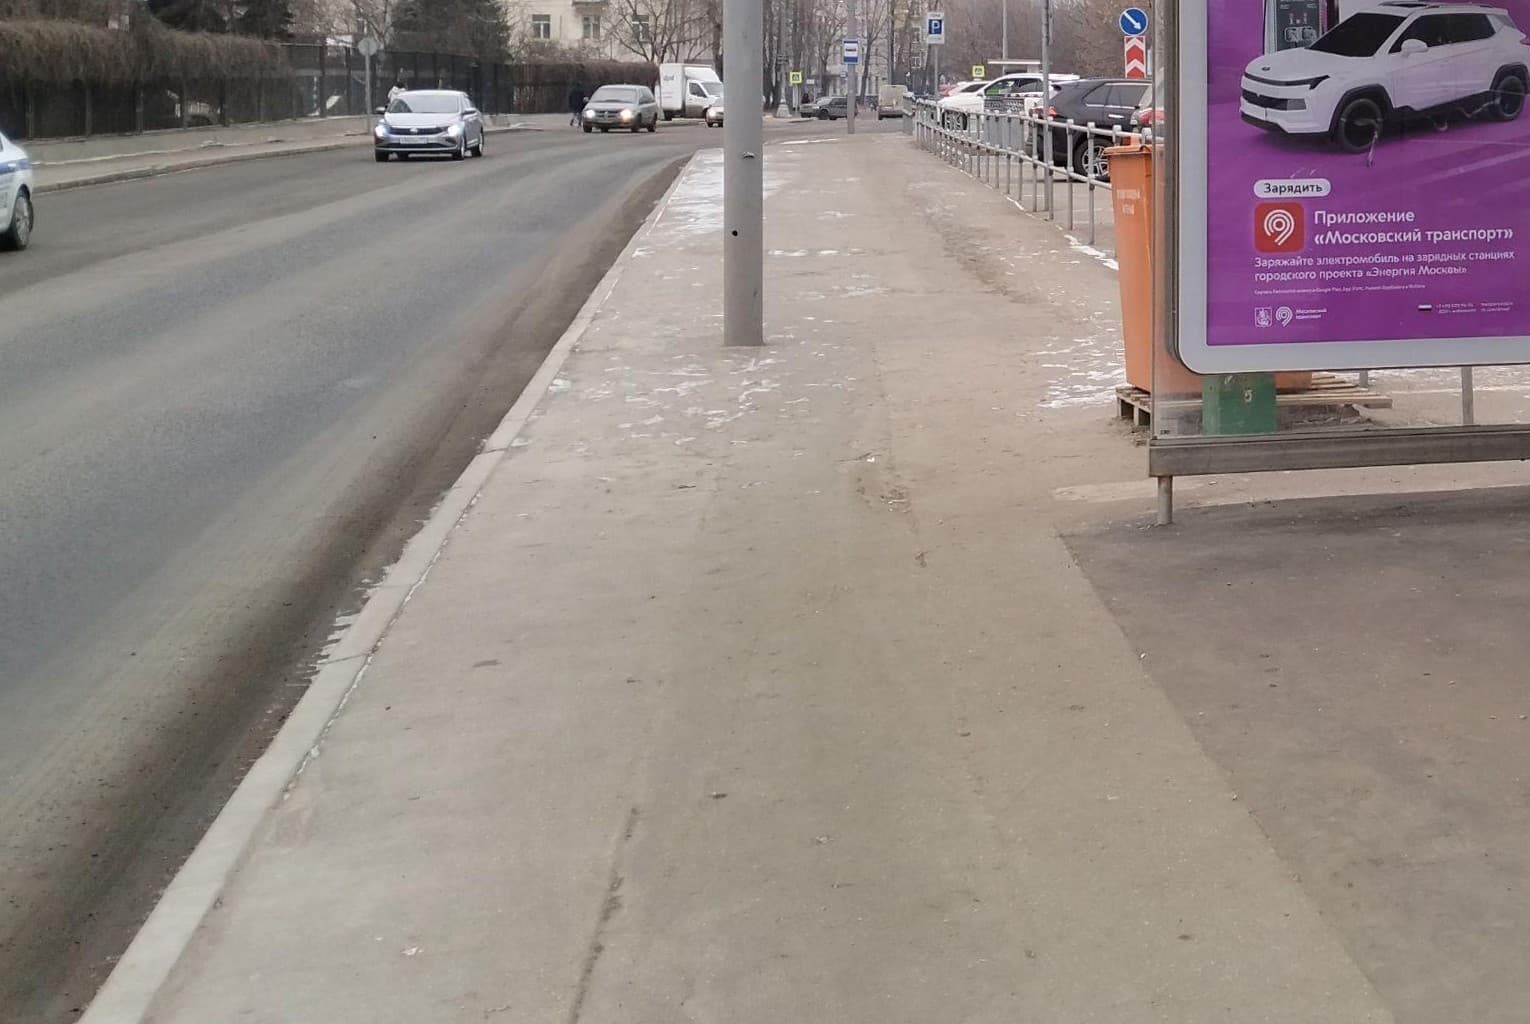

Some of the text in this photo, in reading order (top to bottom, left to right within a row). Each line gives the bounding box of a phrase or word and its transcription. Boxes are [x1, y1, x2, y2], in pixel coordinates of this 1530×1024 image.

[931, 20, 940, 33] P
[1263, 182, 1323, 194] Зарядить
[1314, 210, 1415, 227] Приложение
[1314, 228, 1513, 245] «Московский транспорт»
[1254, 250, 1515, 269] Заряжайте электромобиль на зарядных станциях
[1254, 270, 1317, 283] городского
[1320, 269, 1363, 280] проекта
[1366, 266, 1415, 278] «Энергия
